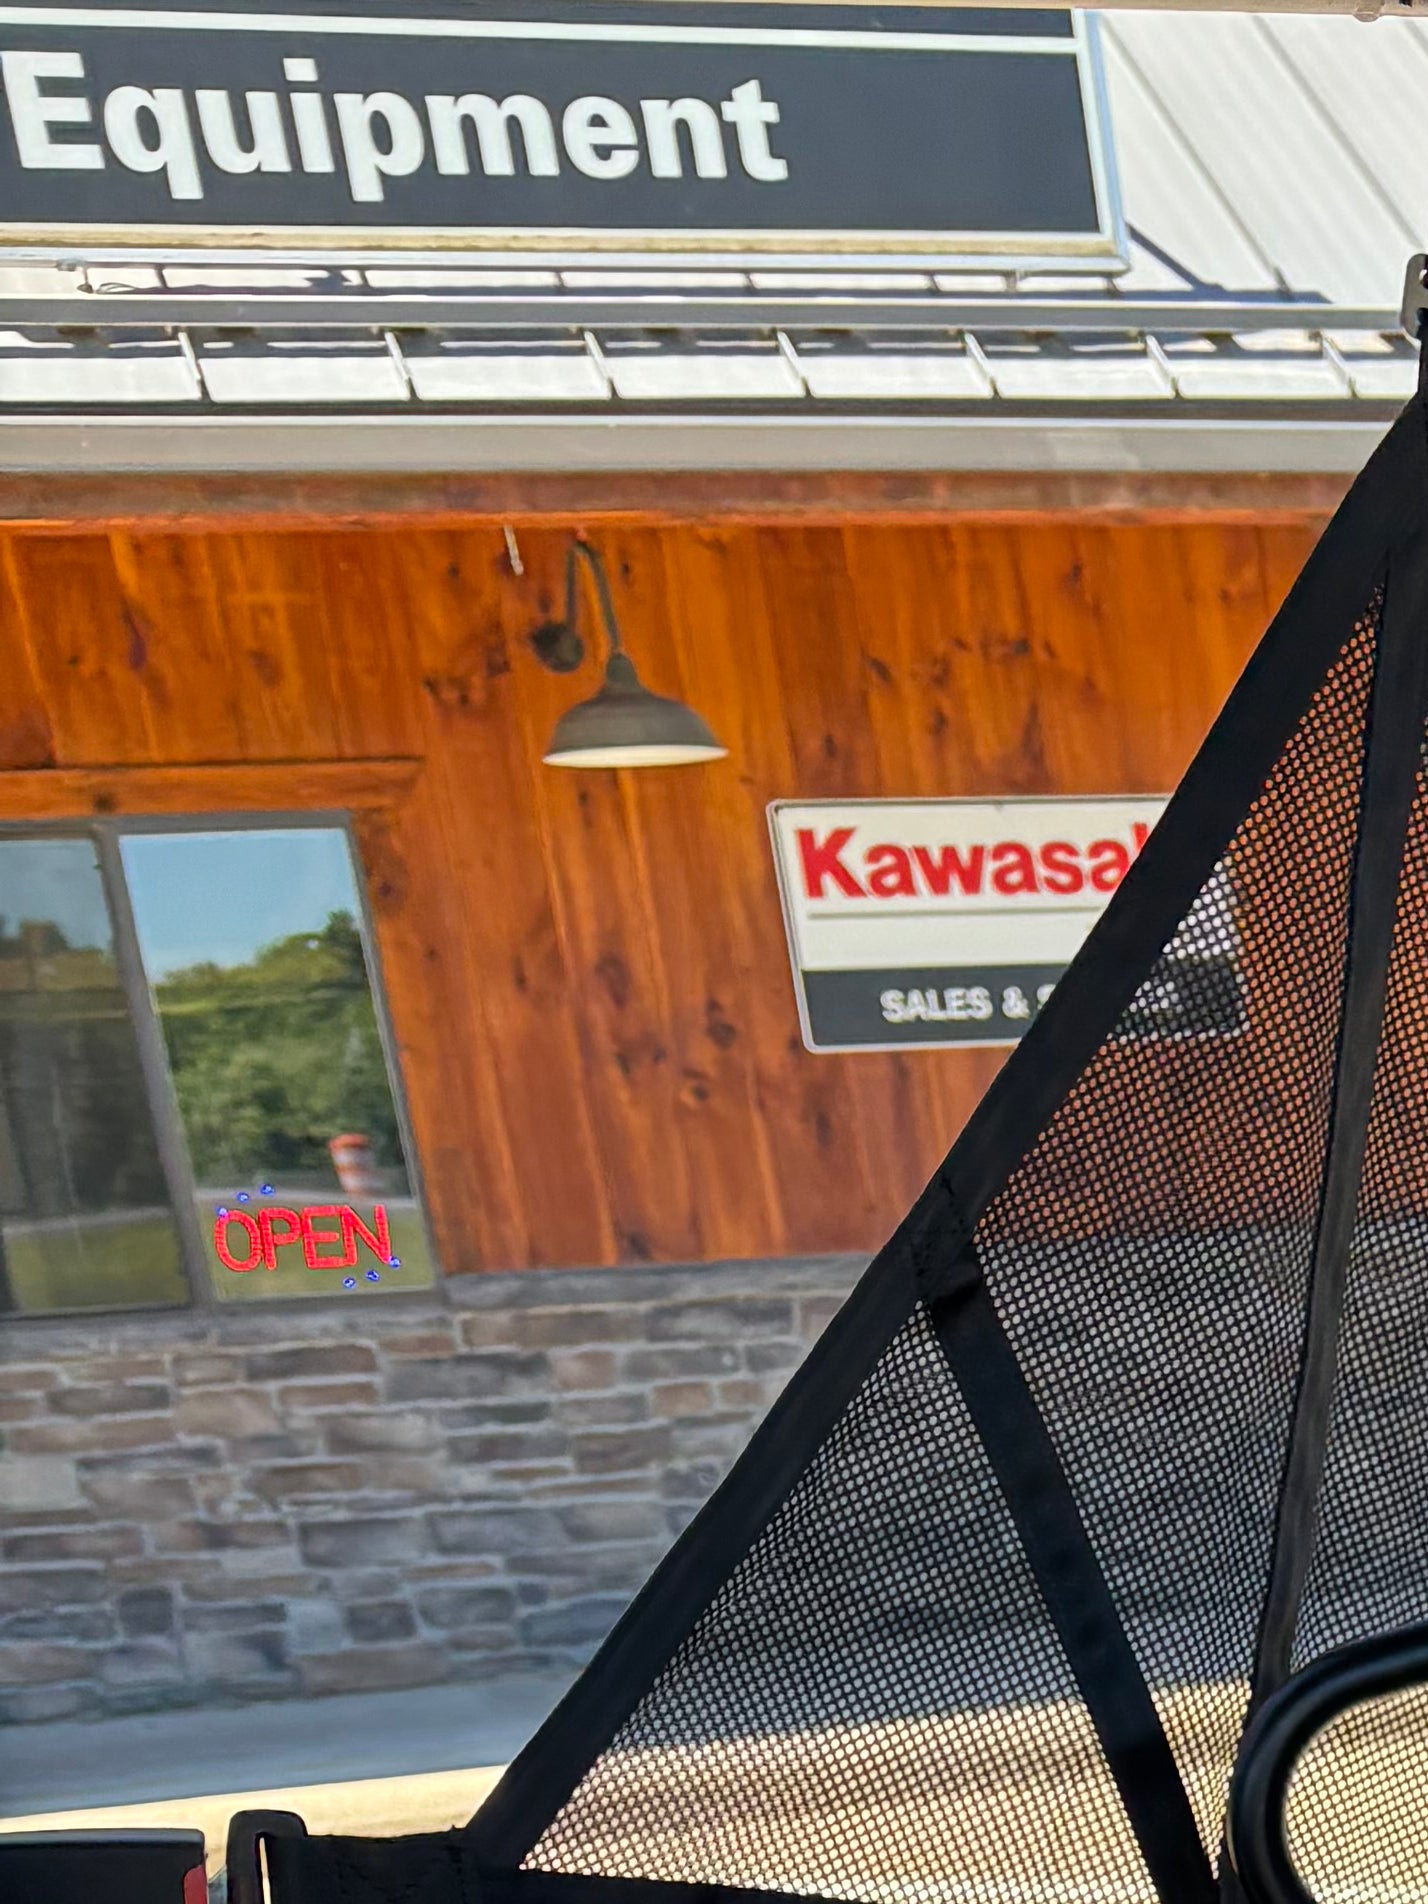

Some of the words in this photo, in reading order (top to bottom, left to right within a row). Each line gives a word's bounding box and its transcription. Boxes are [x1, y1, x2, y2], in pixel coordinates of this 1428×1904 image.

[0, 50, 789, 202] Equipment
[795, 822, 1148, 899] Kawasa
[879, 987, 993, 1024] SALES
[1002, 985, 1031, 1019] &
[213, 1204, 392, 1272] OPEN
